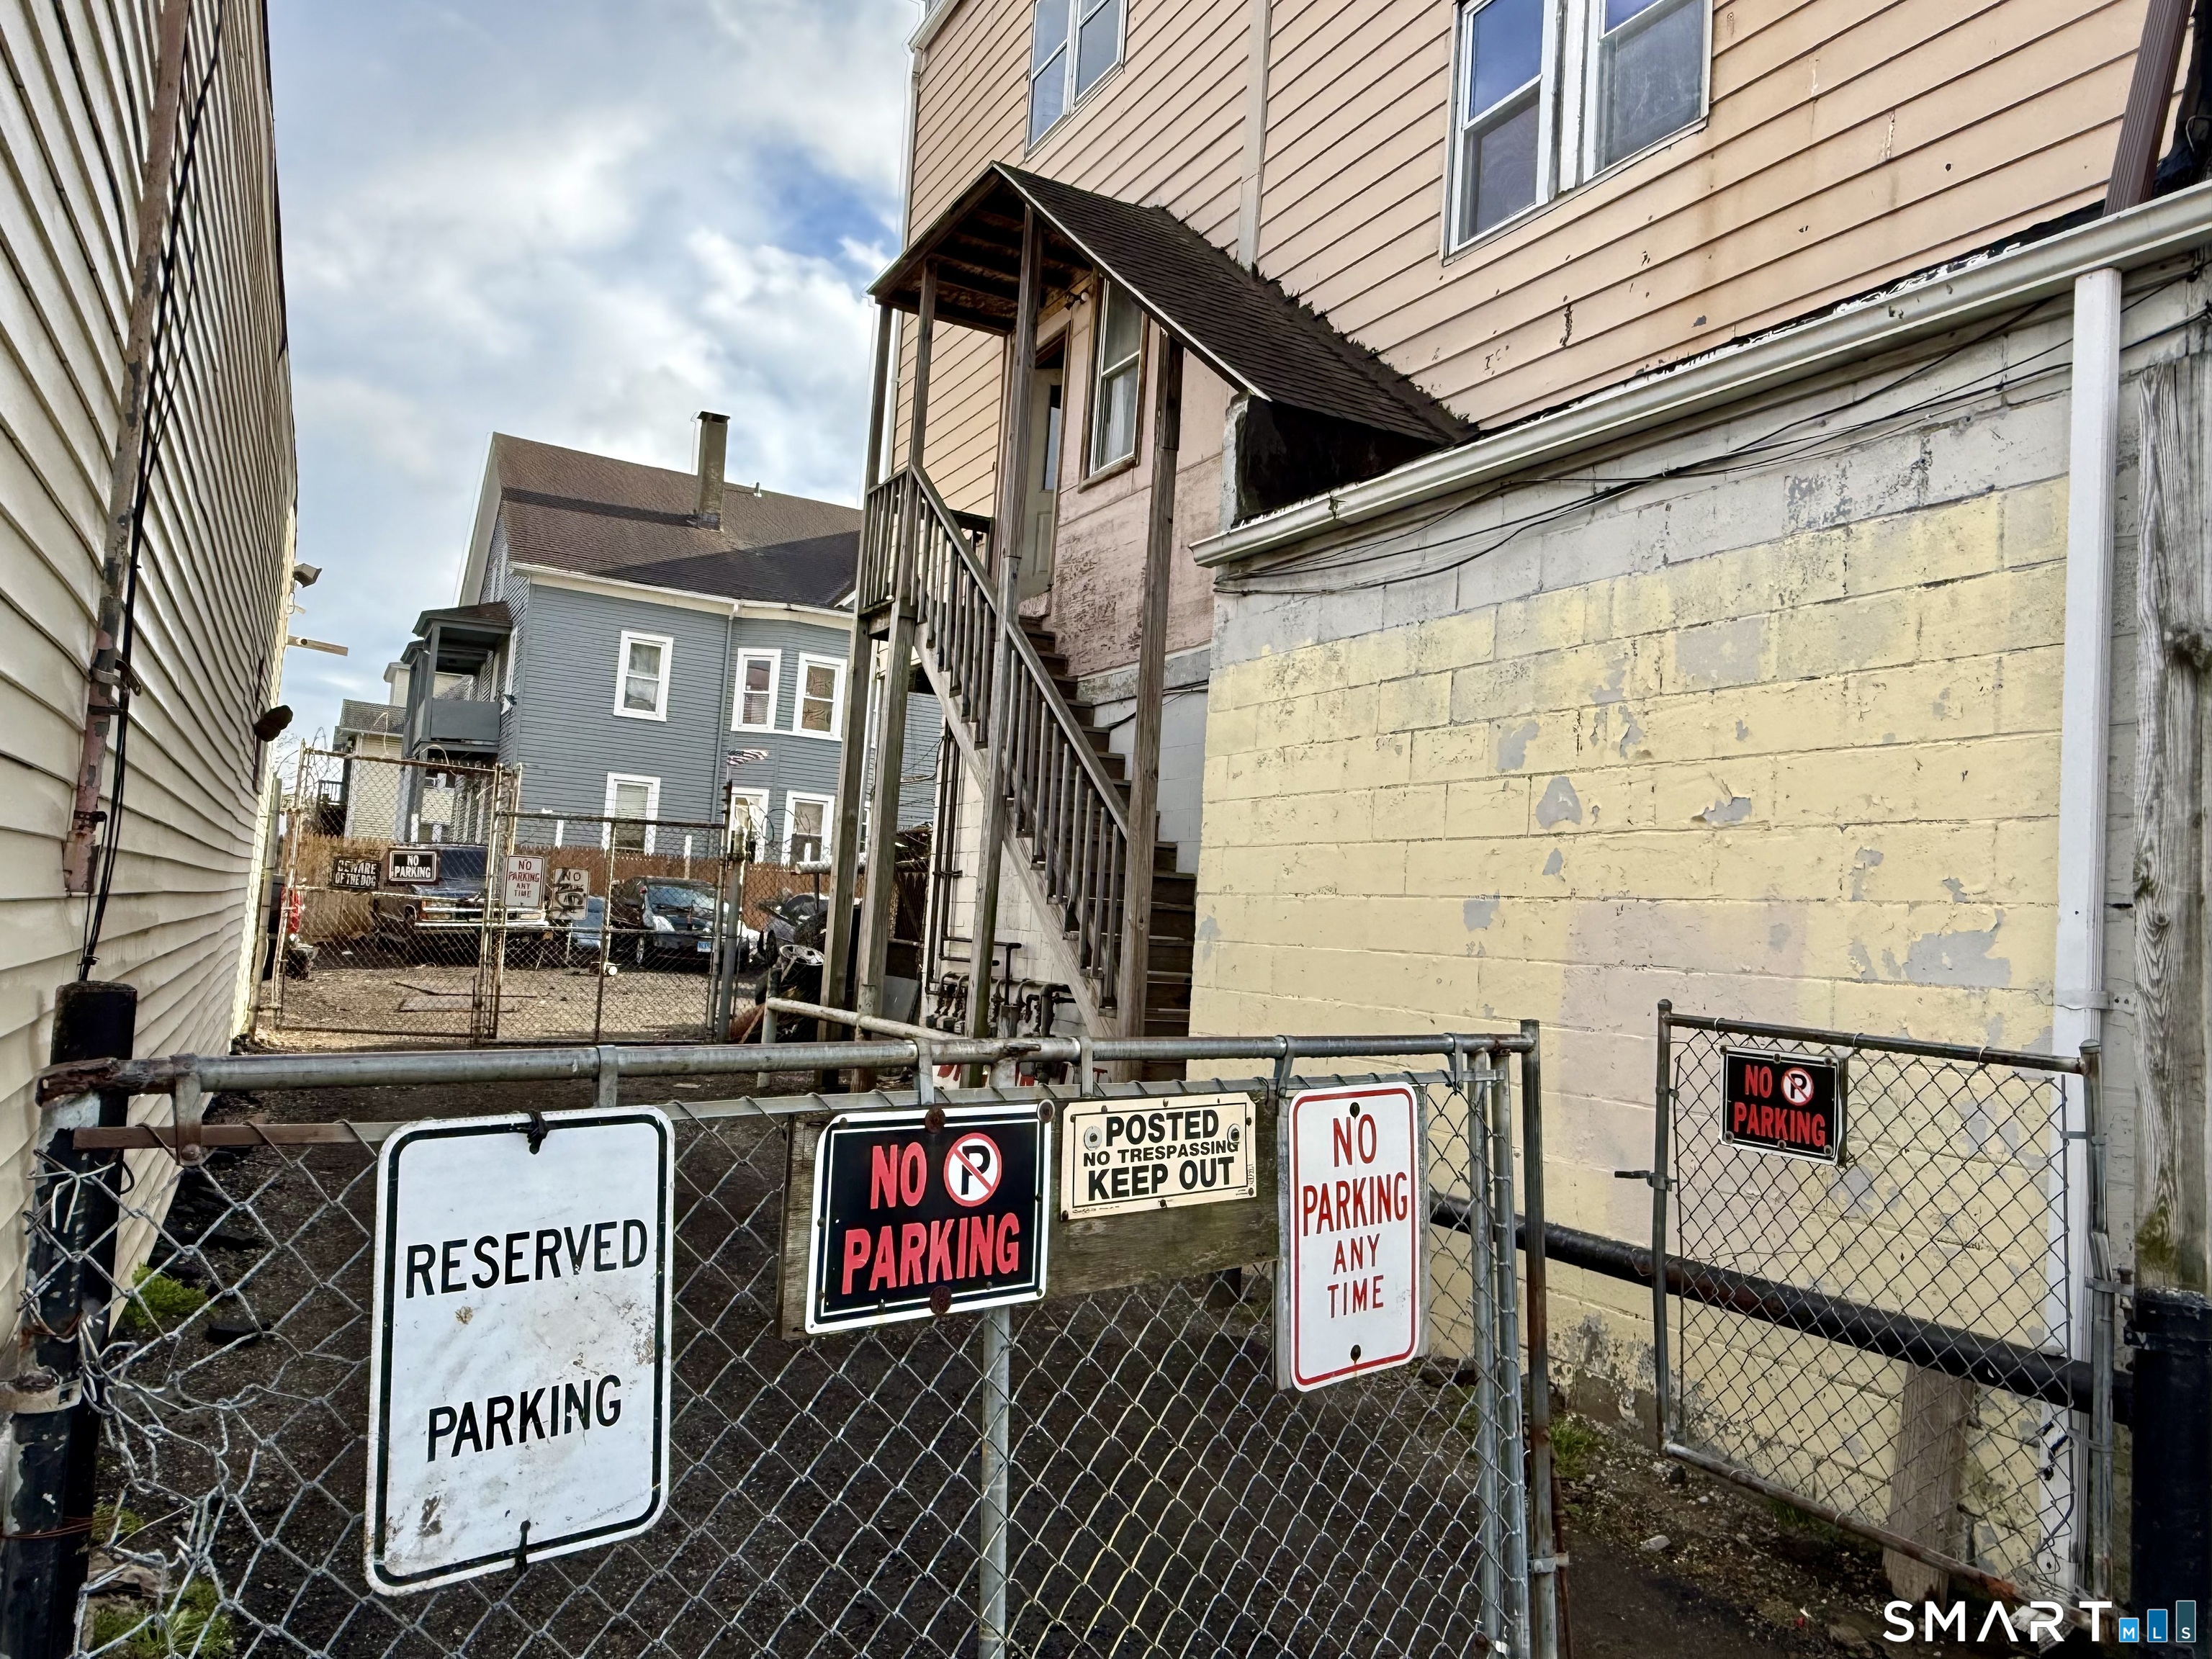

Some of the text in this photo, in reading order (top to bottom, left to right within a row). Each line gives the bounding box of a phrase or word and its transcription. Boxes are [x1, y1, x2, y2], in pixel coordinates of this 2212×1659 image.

[335, 871, 377, 887] OF THE DOG
[338, 860, 377, 875] BEWARE
[394, 866, 431, 878] PARKING
[407, 855, 420, 866] NO
[508, 871, 540, 883] PARKING
[518, 860, 532, 871] NO
[563, 871, 581, 882] NO
[1745, 1064, 1773, 1098] NO
[1105, 1109, 1219, 1147] POSTED
[1333, 1113, 1377, 1167] NO
[1733, 1102, 1825, 1147] PARKING
[1083, 1140, 1240, 1167] NO TRESPASSING
[870, 1141, 927, 1210] NO
[1088, 1163, 1169, 1201] KEEP
[1179, 1156, 1234, 1190] OUT
[1303, 1172, 1408, 1237] PARKING
[405, 1219, 648, 1299] RESERVED
[842, 1213, 1020, 1295] PARKING
[1333, 1233, 1380, 1275] ANY
[1327, 1274, 1384, 1319] TIME
[426, 1374, 622, 1464] PARKING
